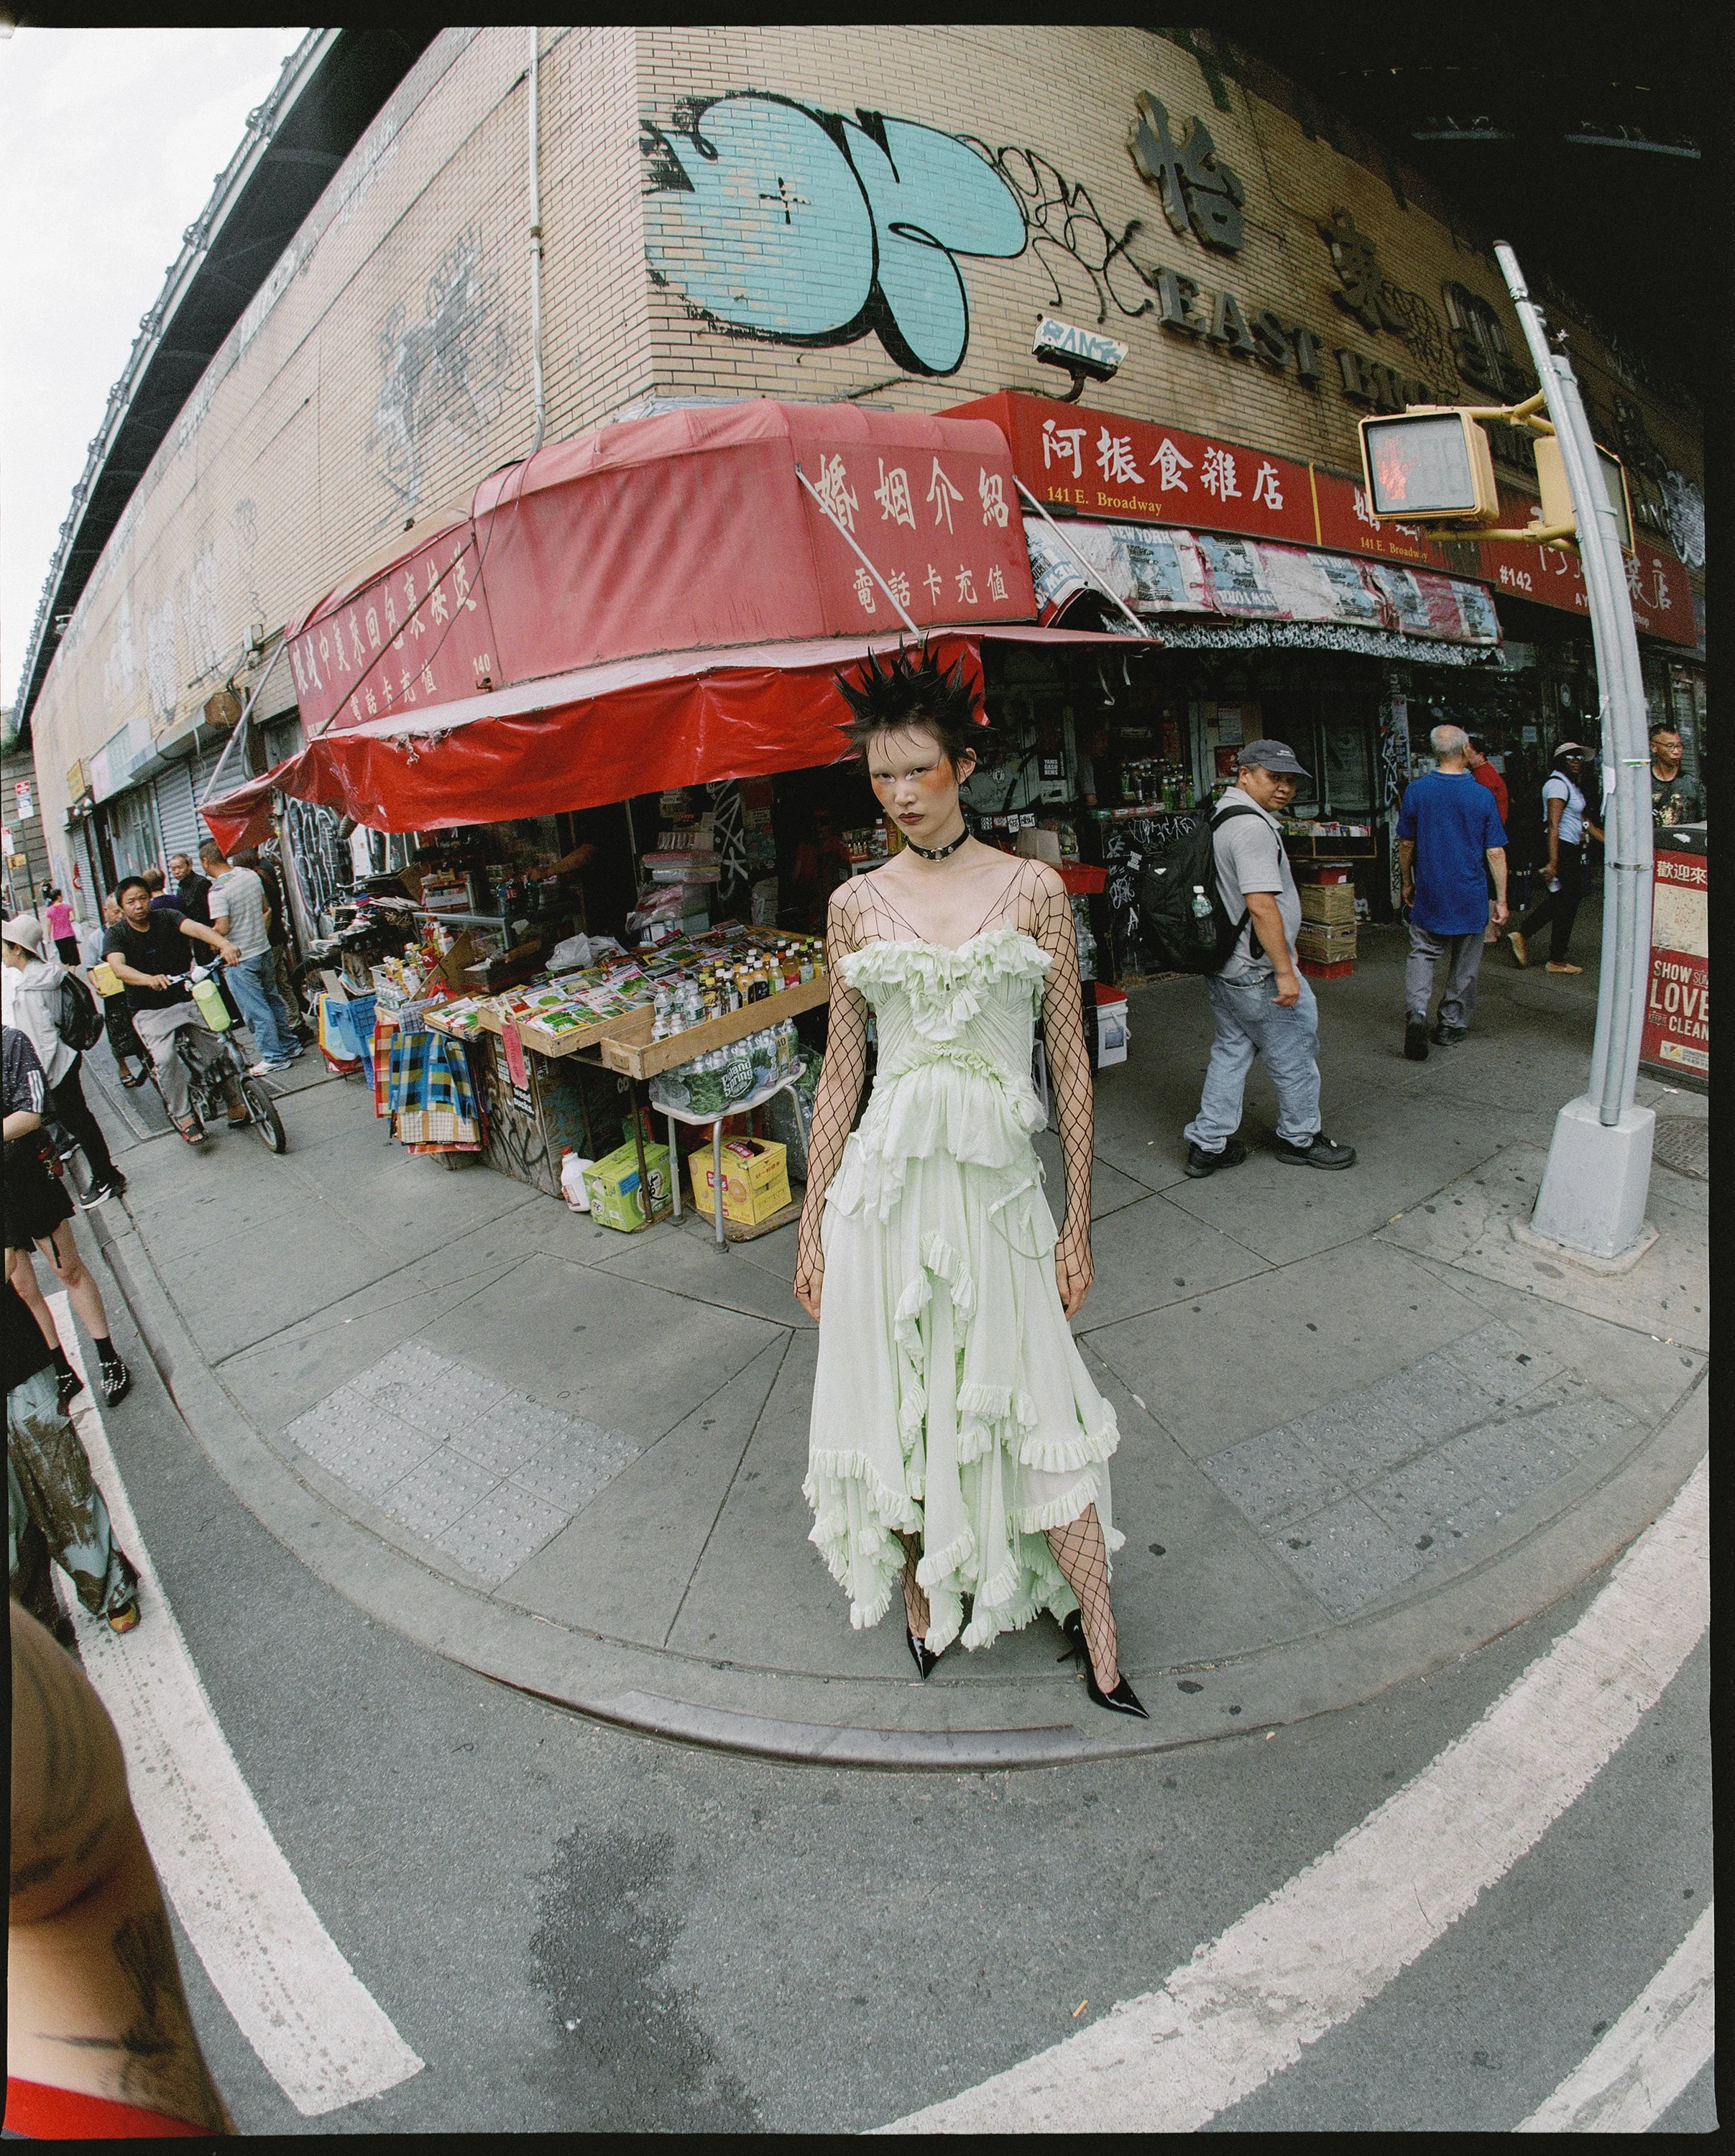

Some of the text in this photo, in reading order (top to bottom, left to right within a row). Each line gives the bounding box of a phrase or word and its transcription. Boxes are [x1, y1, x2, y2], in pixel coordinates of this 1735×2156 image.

[1152, 266, 1323, 384] EAST
[1042, 419, 1284, 510] 阿振食雜店
[814, 453, 1009, 535] 婚姻介紹
[1047, 486, 1162, 516] 141 E. Broadway
[1361, 537, 1375, 550] 141
[1378, 541, 1386, 553] E.
[853, 563, 1009, 614] 電話卡充值
[1499, 565, 1533, 592] #142
[472, 653, 491, 676] 140
[349, 659, 437, 722] 電話卡充值
[1654, 960, 1693, 984] SHOW
[1650, 979, 1708, 1022] LOVE
[1669, 1015, 1708, 1041] CLEAN
[722, 1058, 752, 1087] Poland
[724, 1069, 753, 1097] Spring
